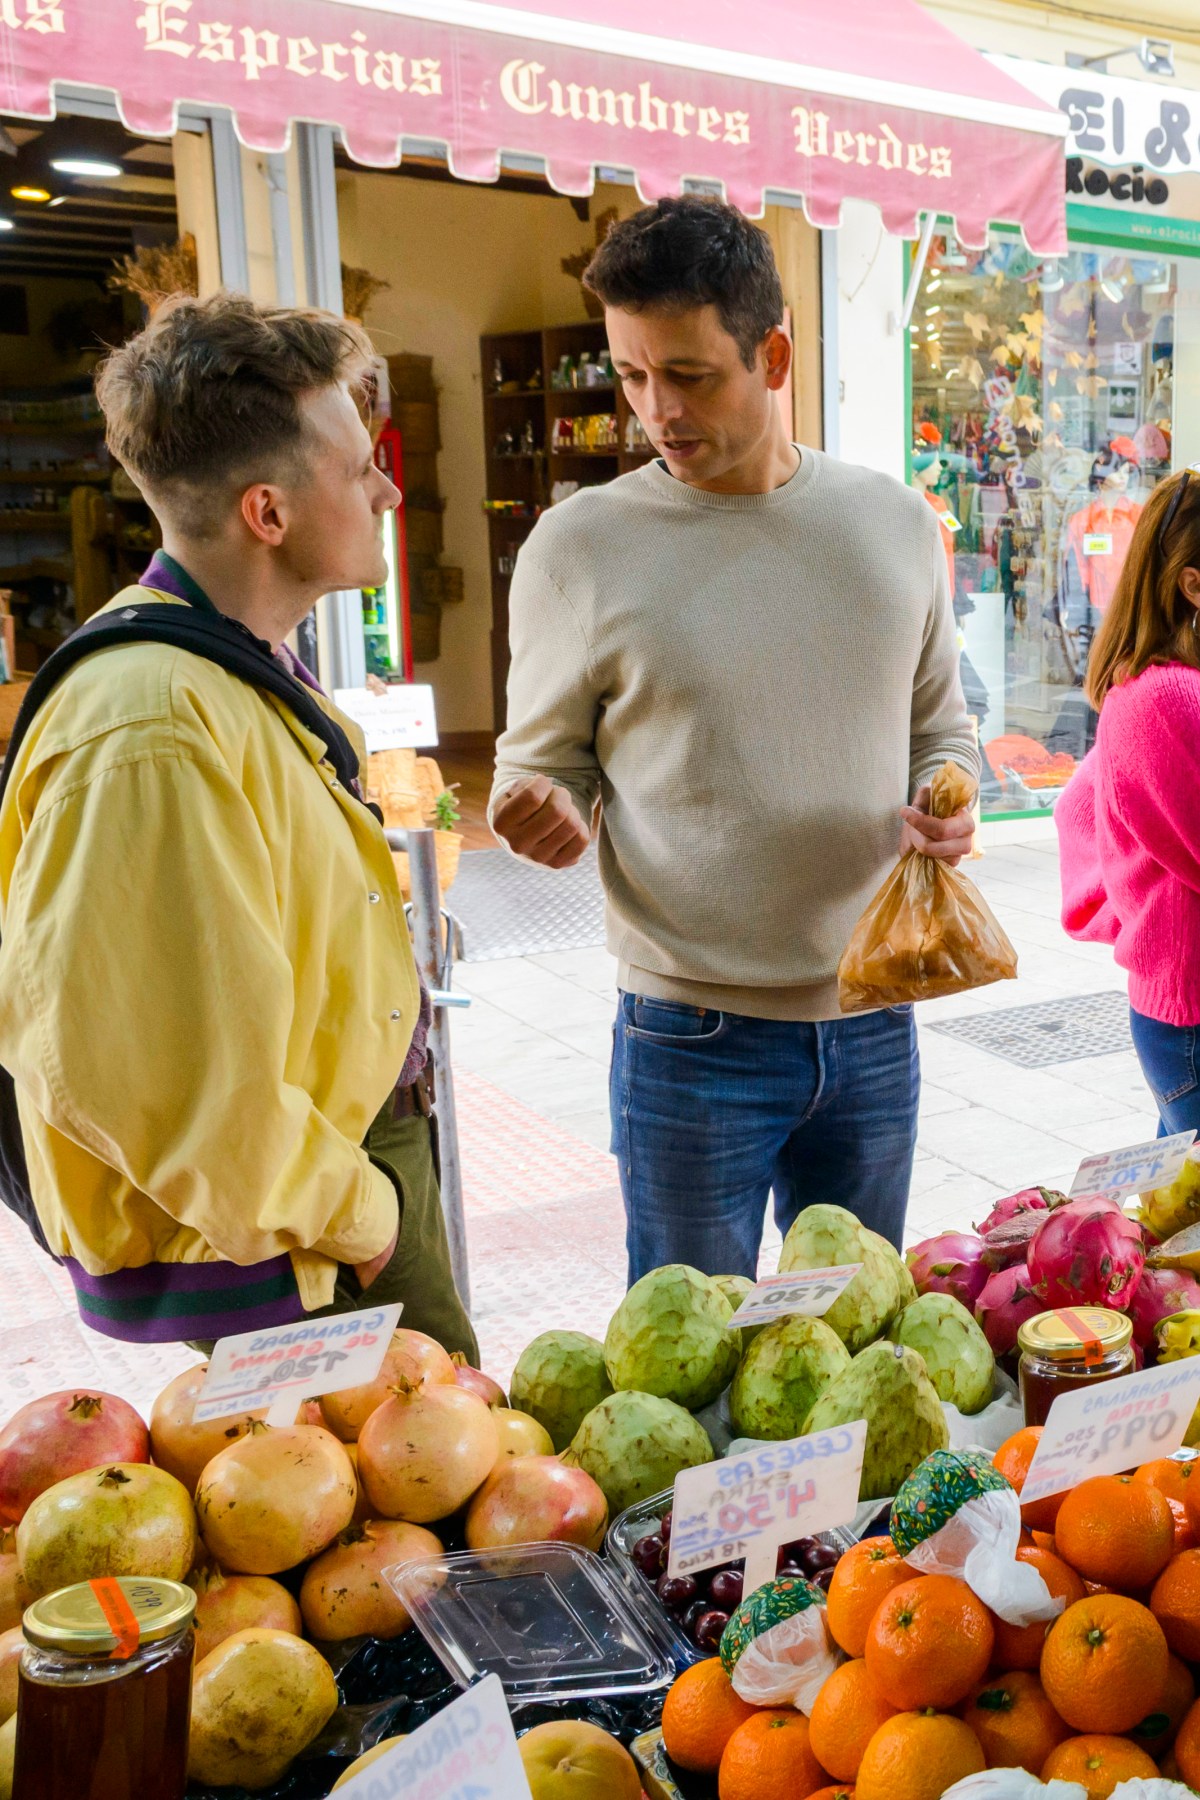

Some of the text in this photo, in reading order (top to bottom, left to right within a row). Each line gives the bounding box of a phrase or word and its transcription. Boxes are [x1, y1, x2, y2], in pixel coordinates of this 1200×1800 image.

[135, 0, 443, 97] Especias
[499, 58, 751, 146] Cumbres
[790, 102, 953, 180] Verdes
[1058, 87, 1126, 156] El
[1065, 156, 1169, 205] Rocio
